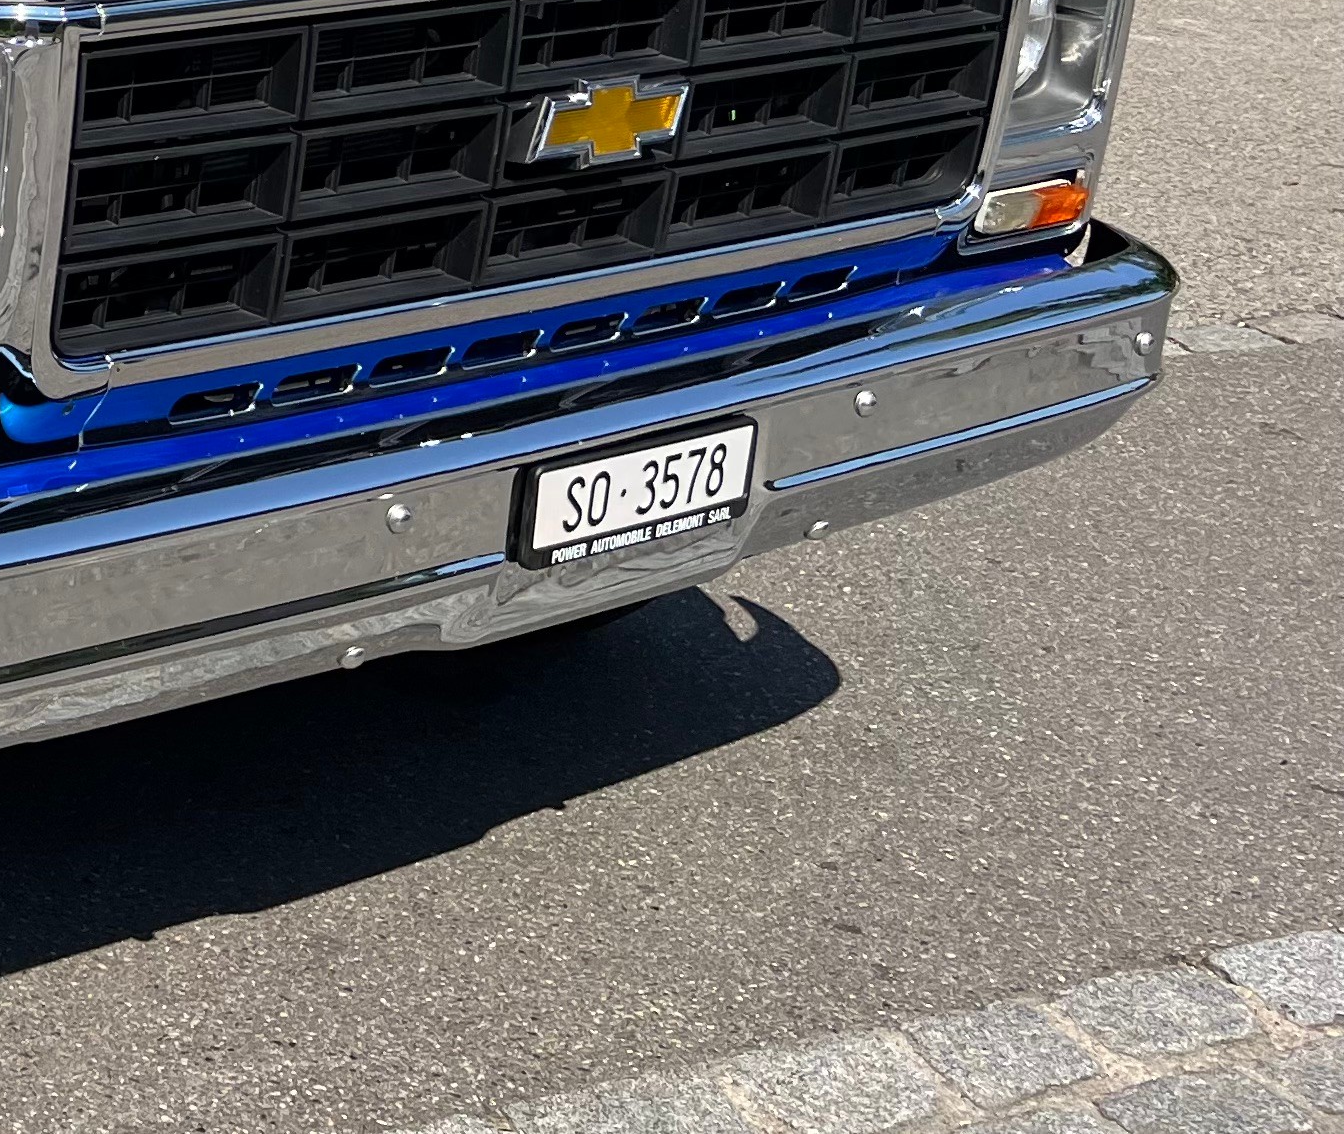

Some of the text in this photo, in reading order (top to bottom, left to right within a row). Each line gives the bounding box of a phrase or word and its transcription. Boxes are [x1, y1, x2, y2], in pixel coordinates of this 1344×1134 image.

[562, 442, 728, 533] SO 3578
[551, 506, 732, 565] POWER AUTOMOBILE DELEMONT SARL
